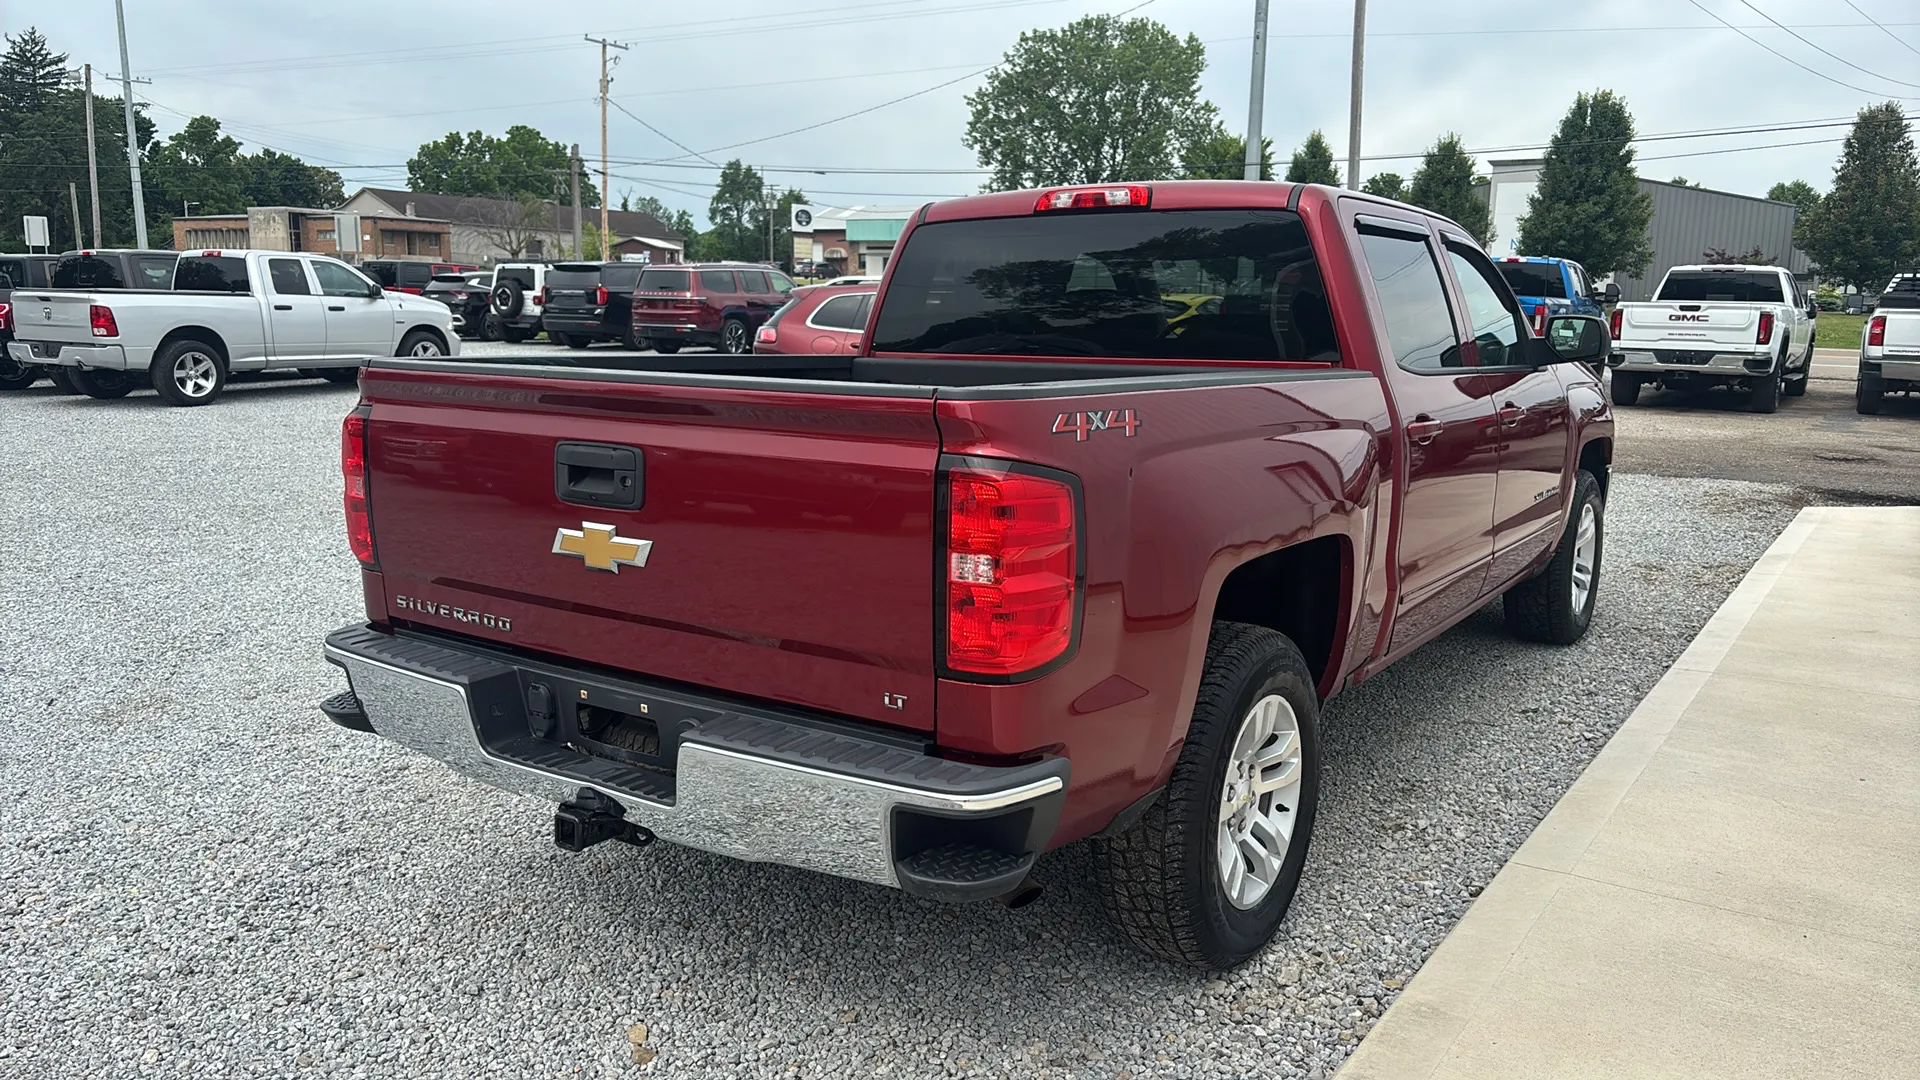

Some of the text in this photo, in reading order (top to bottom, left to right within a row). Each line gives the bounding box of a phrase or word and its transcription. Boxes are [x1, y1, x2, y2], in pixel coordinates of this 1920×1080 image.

[1668, 314, 1710, 322] GMC
[396, 595, 512, 631] SILVERADO
[884, 692, 908, 711] LT
